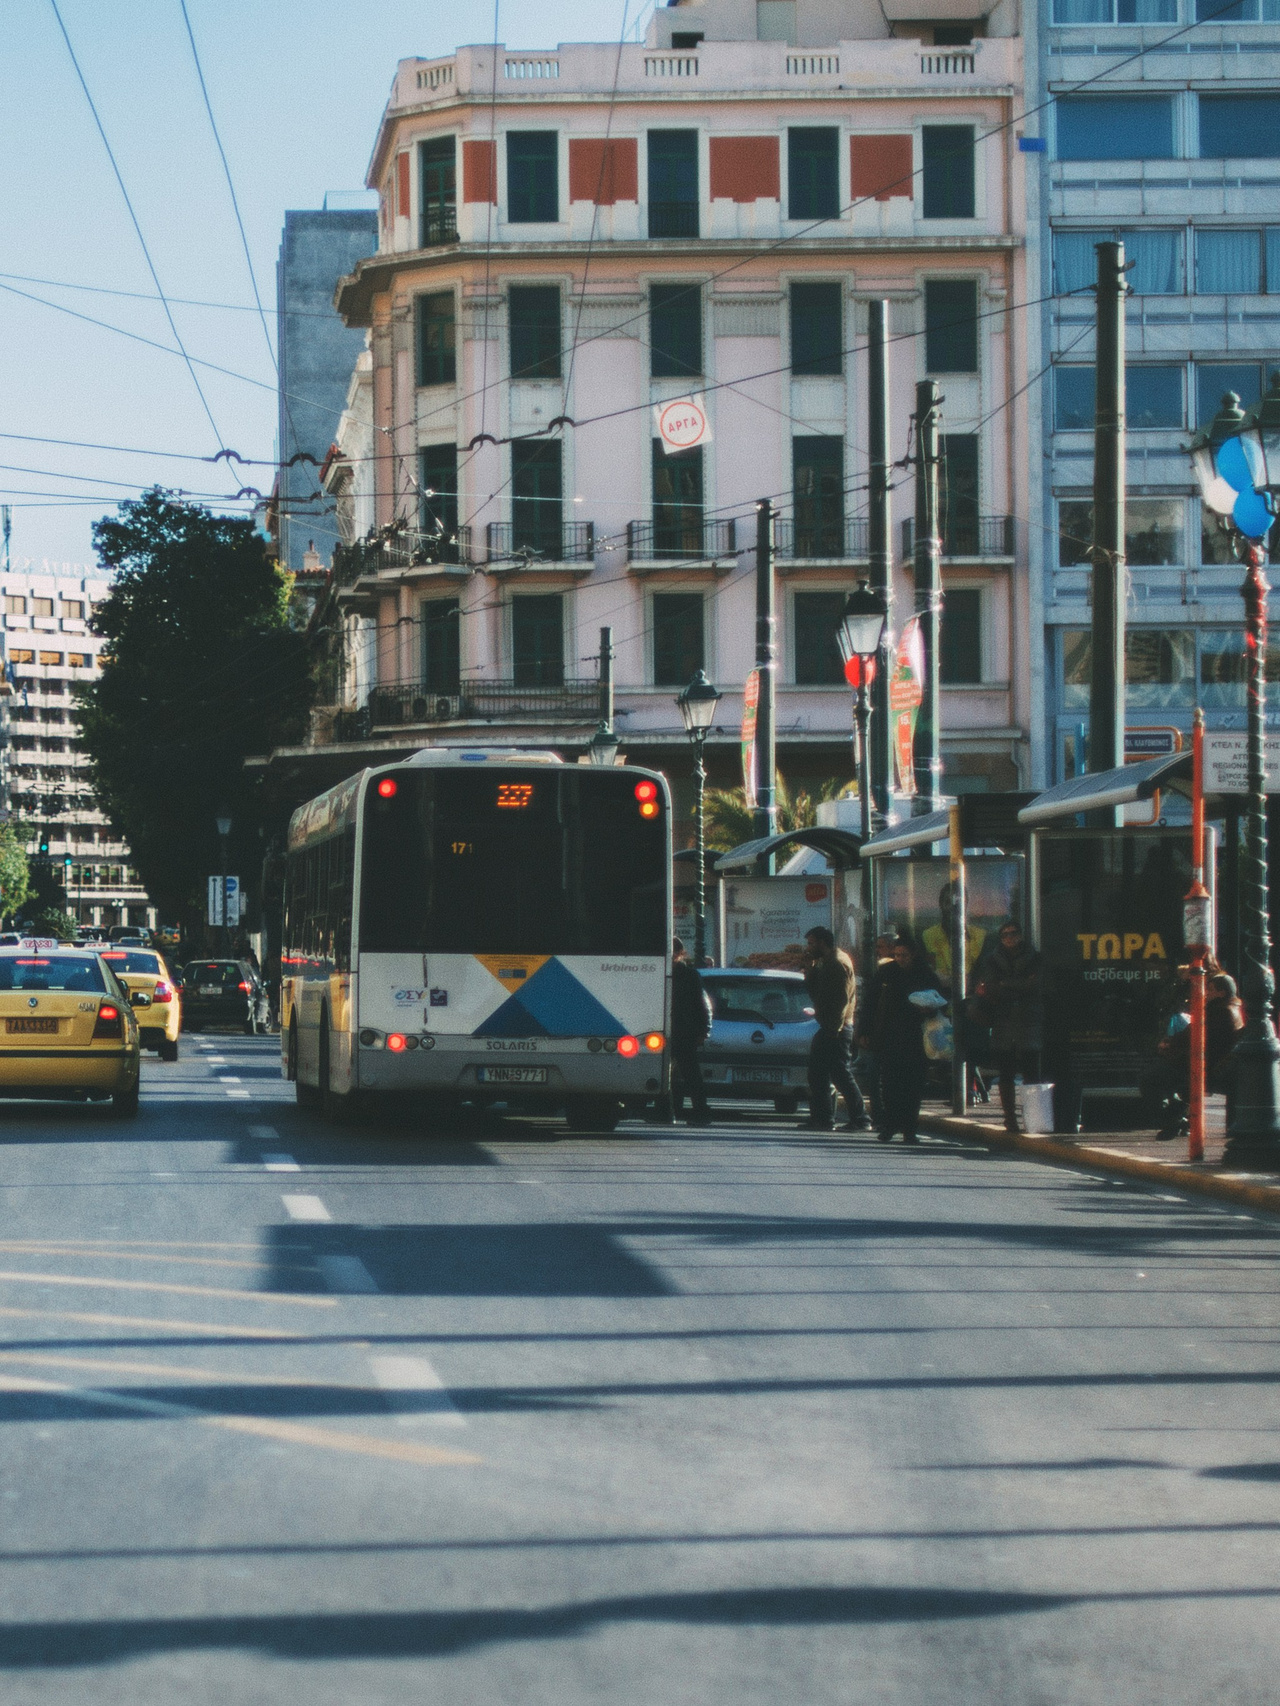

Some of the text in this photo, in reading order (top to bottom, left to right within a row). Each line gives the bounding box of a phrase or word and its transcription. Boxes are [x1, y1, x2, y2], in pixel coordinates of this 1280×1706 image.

[668, 416, 698, 433] ΑΡΓΑ
[23, 940, 53, 949] TAXI
[1075, 932, 1167, 960] ΤΩΡΑ
[600, 963, 639, 972] Urbino
[1083, 967, 1162, 983] ταξίδεψε με
[486, 1041, 537, 1051] SOLARIS
